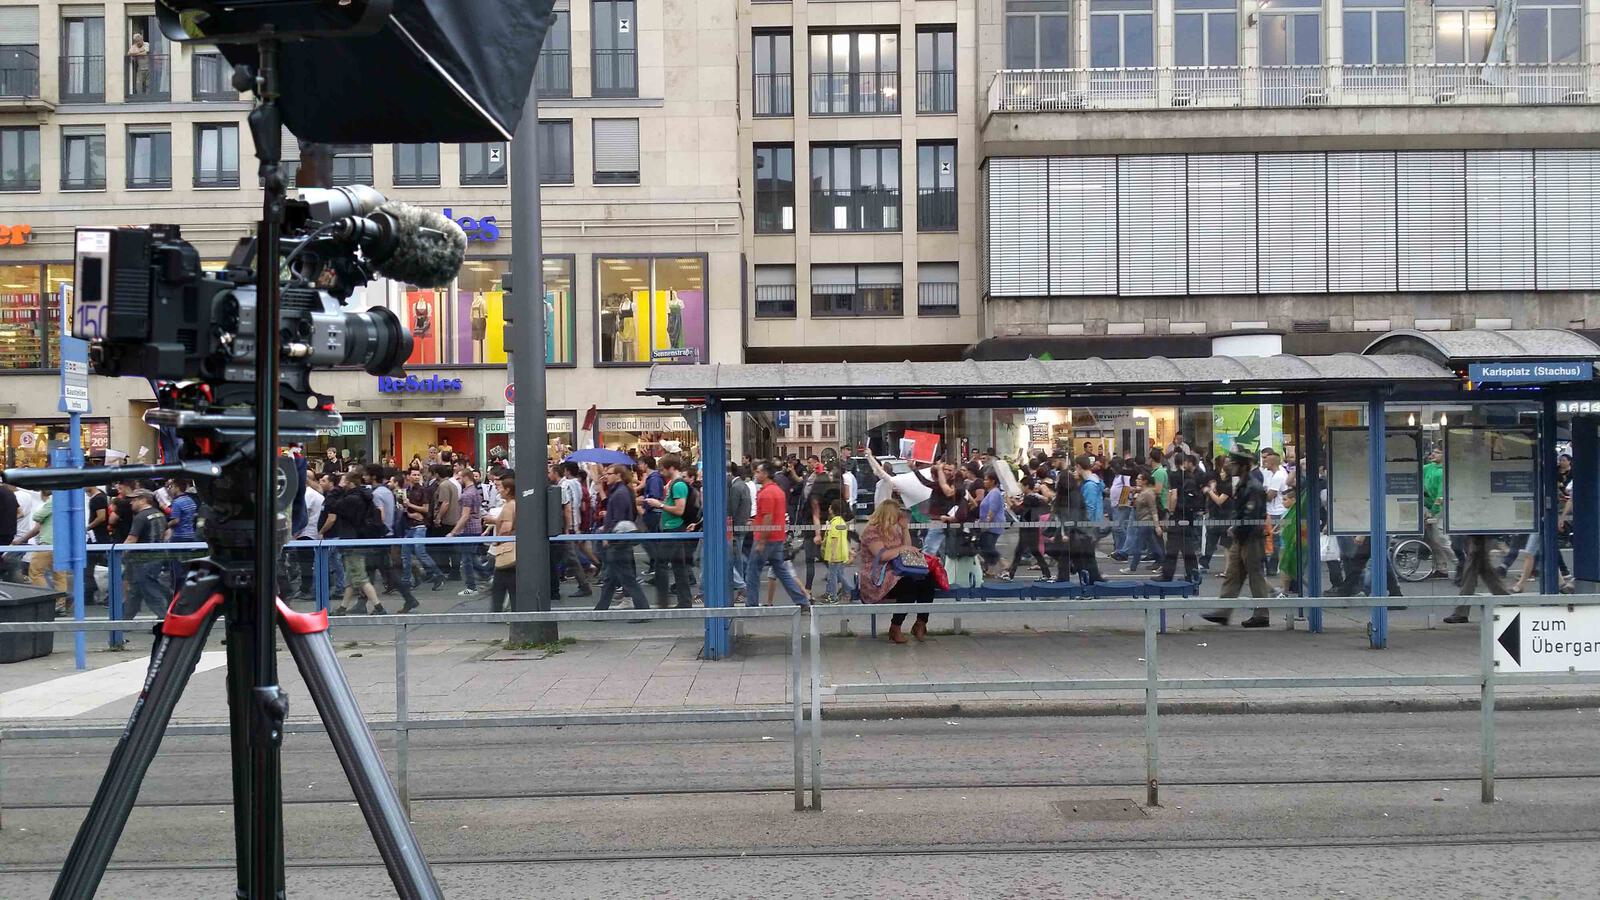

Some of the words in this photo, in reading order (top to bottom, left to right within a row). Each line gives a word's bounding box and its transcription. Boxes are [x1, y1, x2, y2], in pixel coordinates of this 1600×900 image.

[1482, 367, 1531, 377] Karlsplatz
[1534, 366, 1581, 377] (Stachus)
[378, 374, 463, 394] ReSales
[340, 424, 364, 433] more
[547, 422, 570, 431] more
[606, 418, 637, 430] second
[640, 418, 660, 429] hand
[1531, 619, 1567, 632] zum
